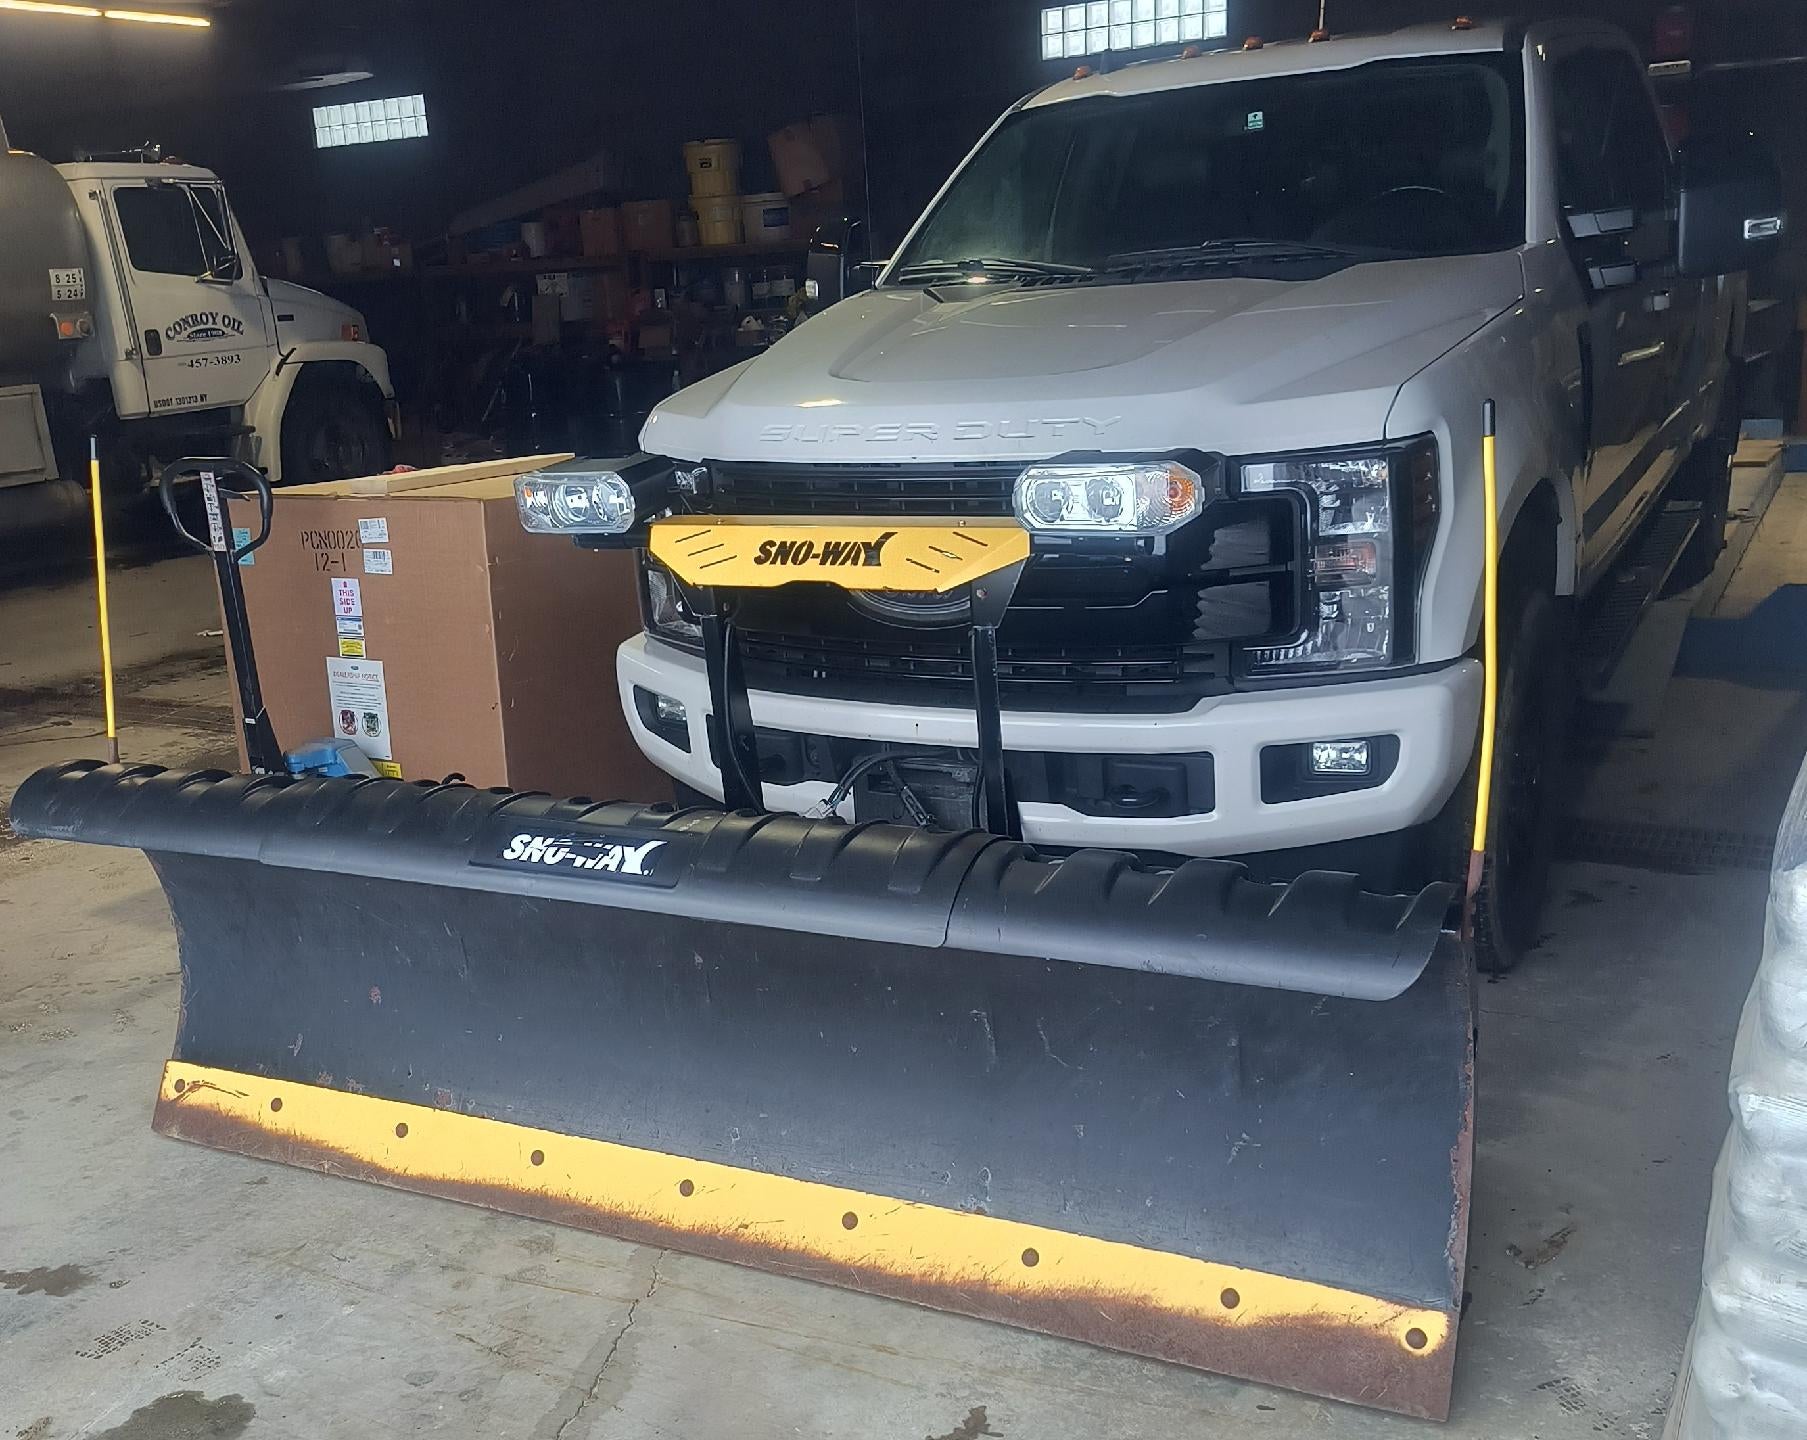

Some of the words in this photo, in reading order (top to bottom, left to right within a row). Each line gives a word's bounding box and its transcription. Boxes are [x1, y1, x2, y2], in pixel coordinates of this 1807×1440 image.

[55, 273, 61, 284] 8
[65, 273, 77, 284] 25
[165, 311, 219, 341] CONROY
[221, 314, 245, 336] OIL
[187, 353, 241, 368] 457-3893
[760, 422, 940, 443] SUPER
[953, 415, 1122, 441] DUTY
[753, 531, 898, 568] SNO-WAY
[314, 551, 347, 573] 12-1
[338, 589, 355, 597] THIS
[339, 598, 356, 606] SIDE
[343, 606, 353, 614] UP
[502, 833, 668, 876] SNO-WAY
